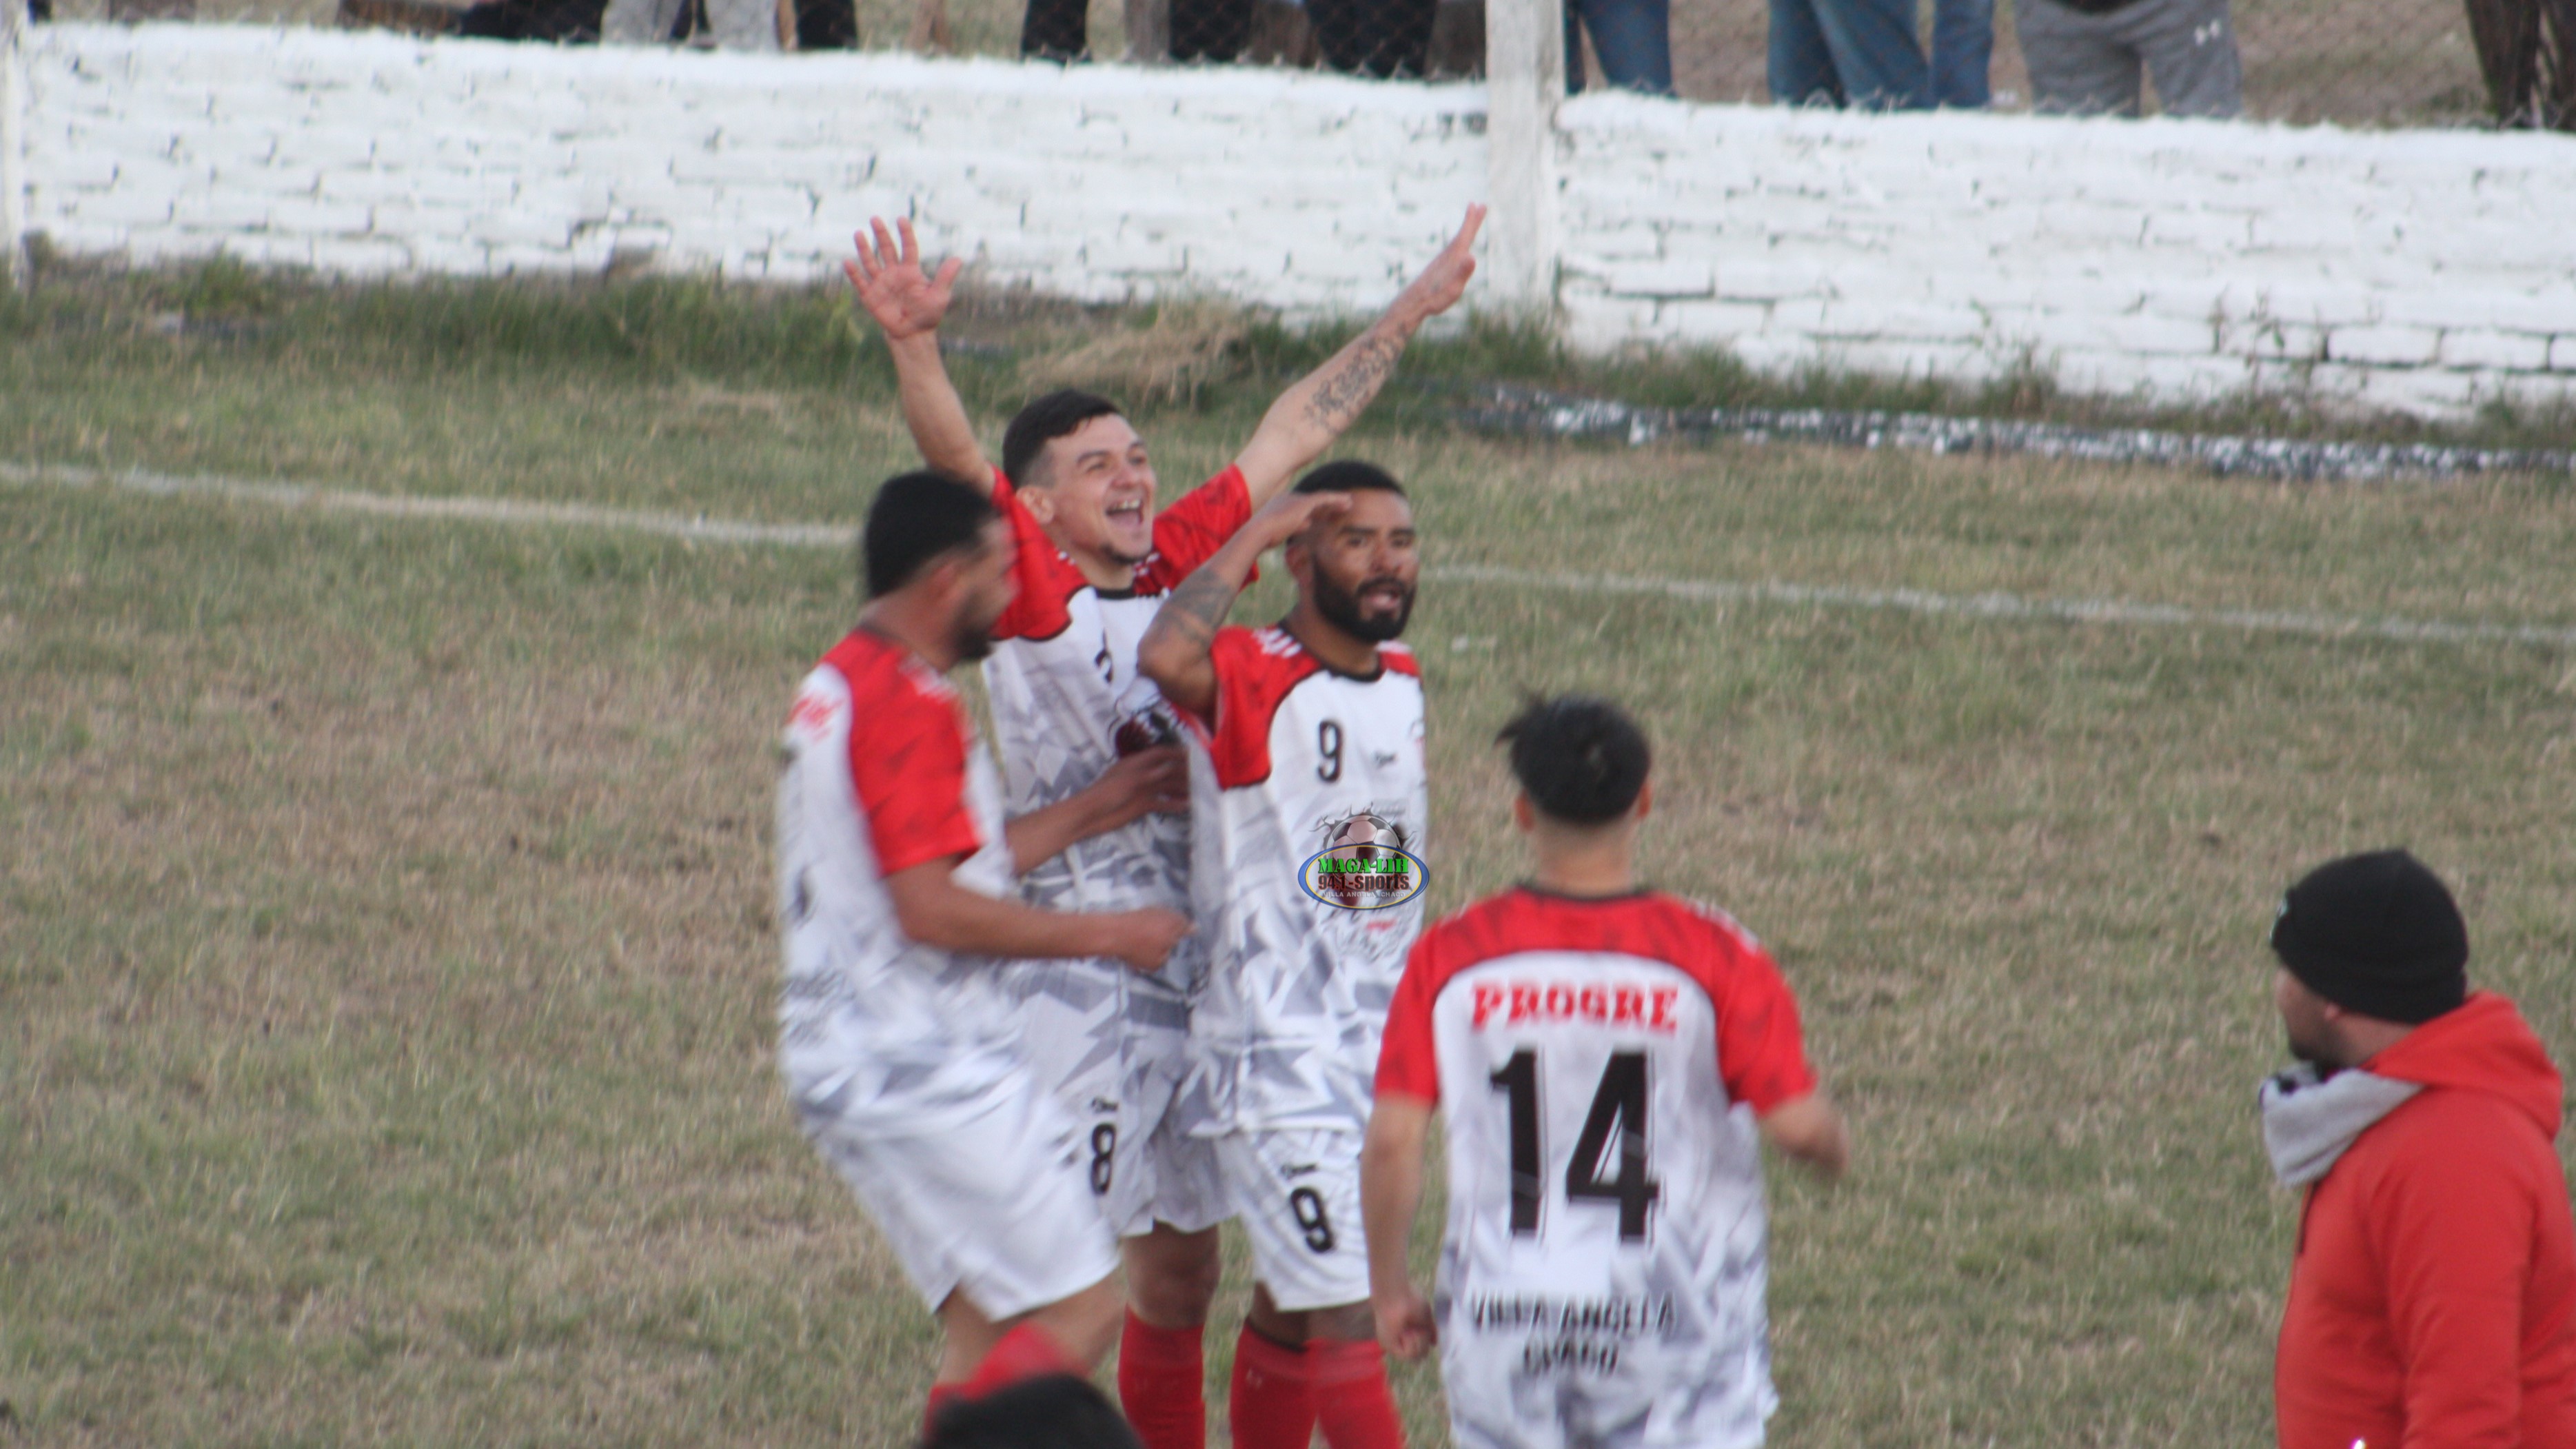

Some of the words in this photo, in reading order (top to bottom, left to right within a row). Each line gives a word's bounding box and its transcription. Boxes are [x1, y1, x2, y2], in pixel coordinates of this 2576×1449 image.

[1317, 720, 1343, 783] 9
[1471, 980, 1678, 1035] PROGRE
[1090, 1124, 1115, 1195] 8
[1489, 1043, 1663, 1245] 14
[1289, 1186, 1336, 1254] 9
